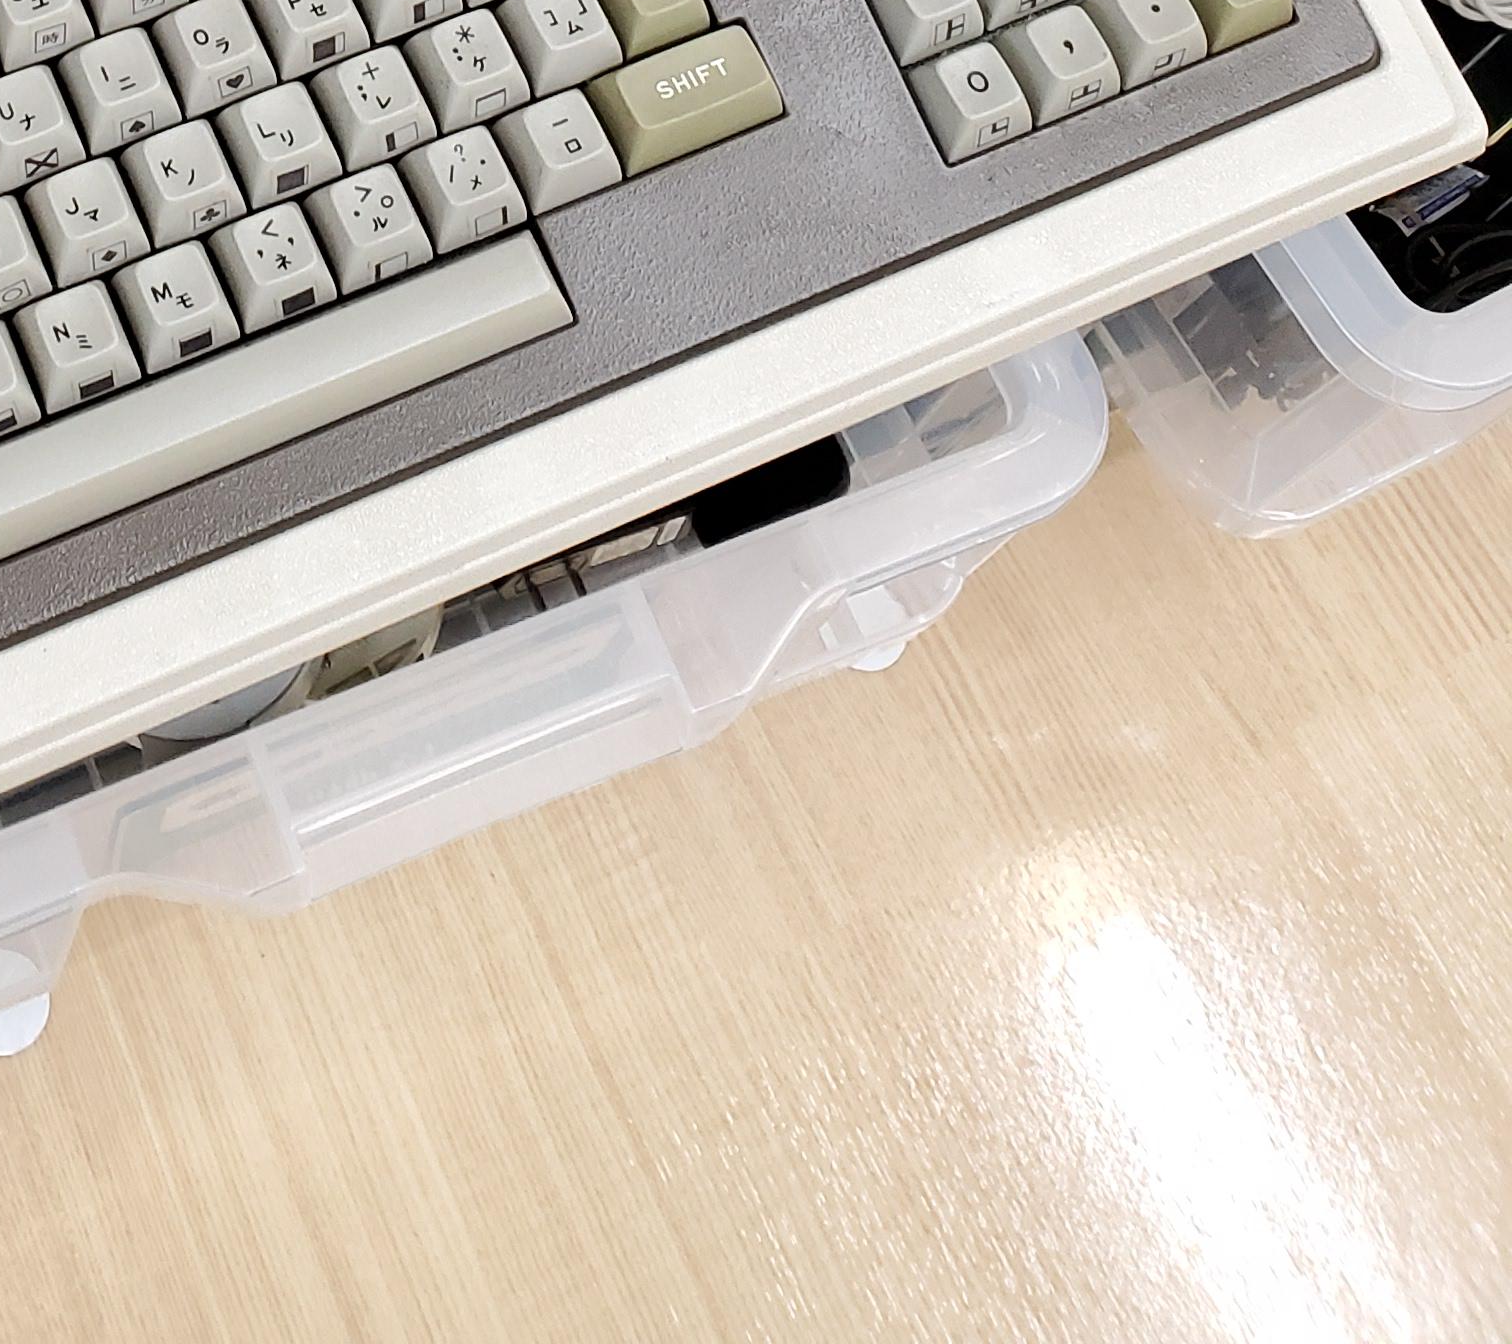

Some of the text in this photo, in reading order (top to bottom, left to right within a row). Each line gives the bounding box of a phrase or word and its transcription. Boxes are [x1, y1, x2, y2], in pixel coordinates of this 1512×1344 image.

[655, 57, 729, 100] SHIFT
[967, 71, 989, 93] 0
[257, 123, 275, 139] L
[161, 159, 179, 177] K
[65, 197, 79, 215] J
[150, 282, 174, 304] M
[52, 322, 70, 343] N
